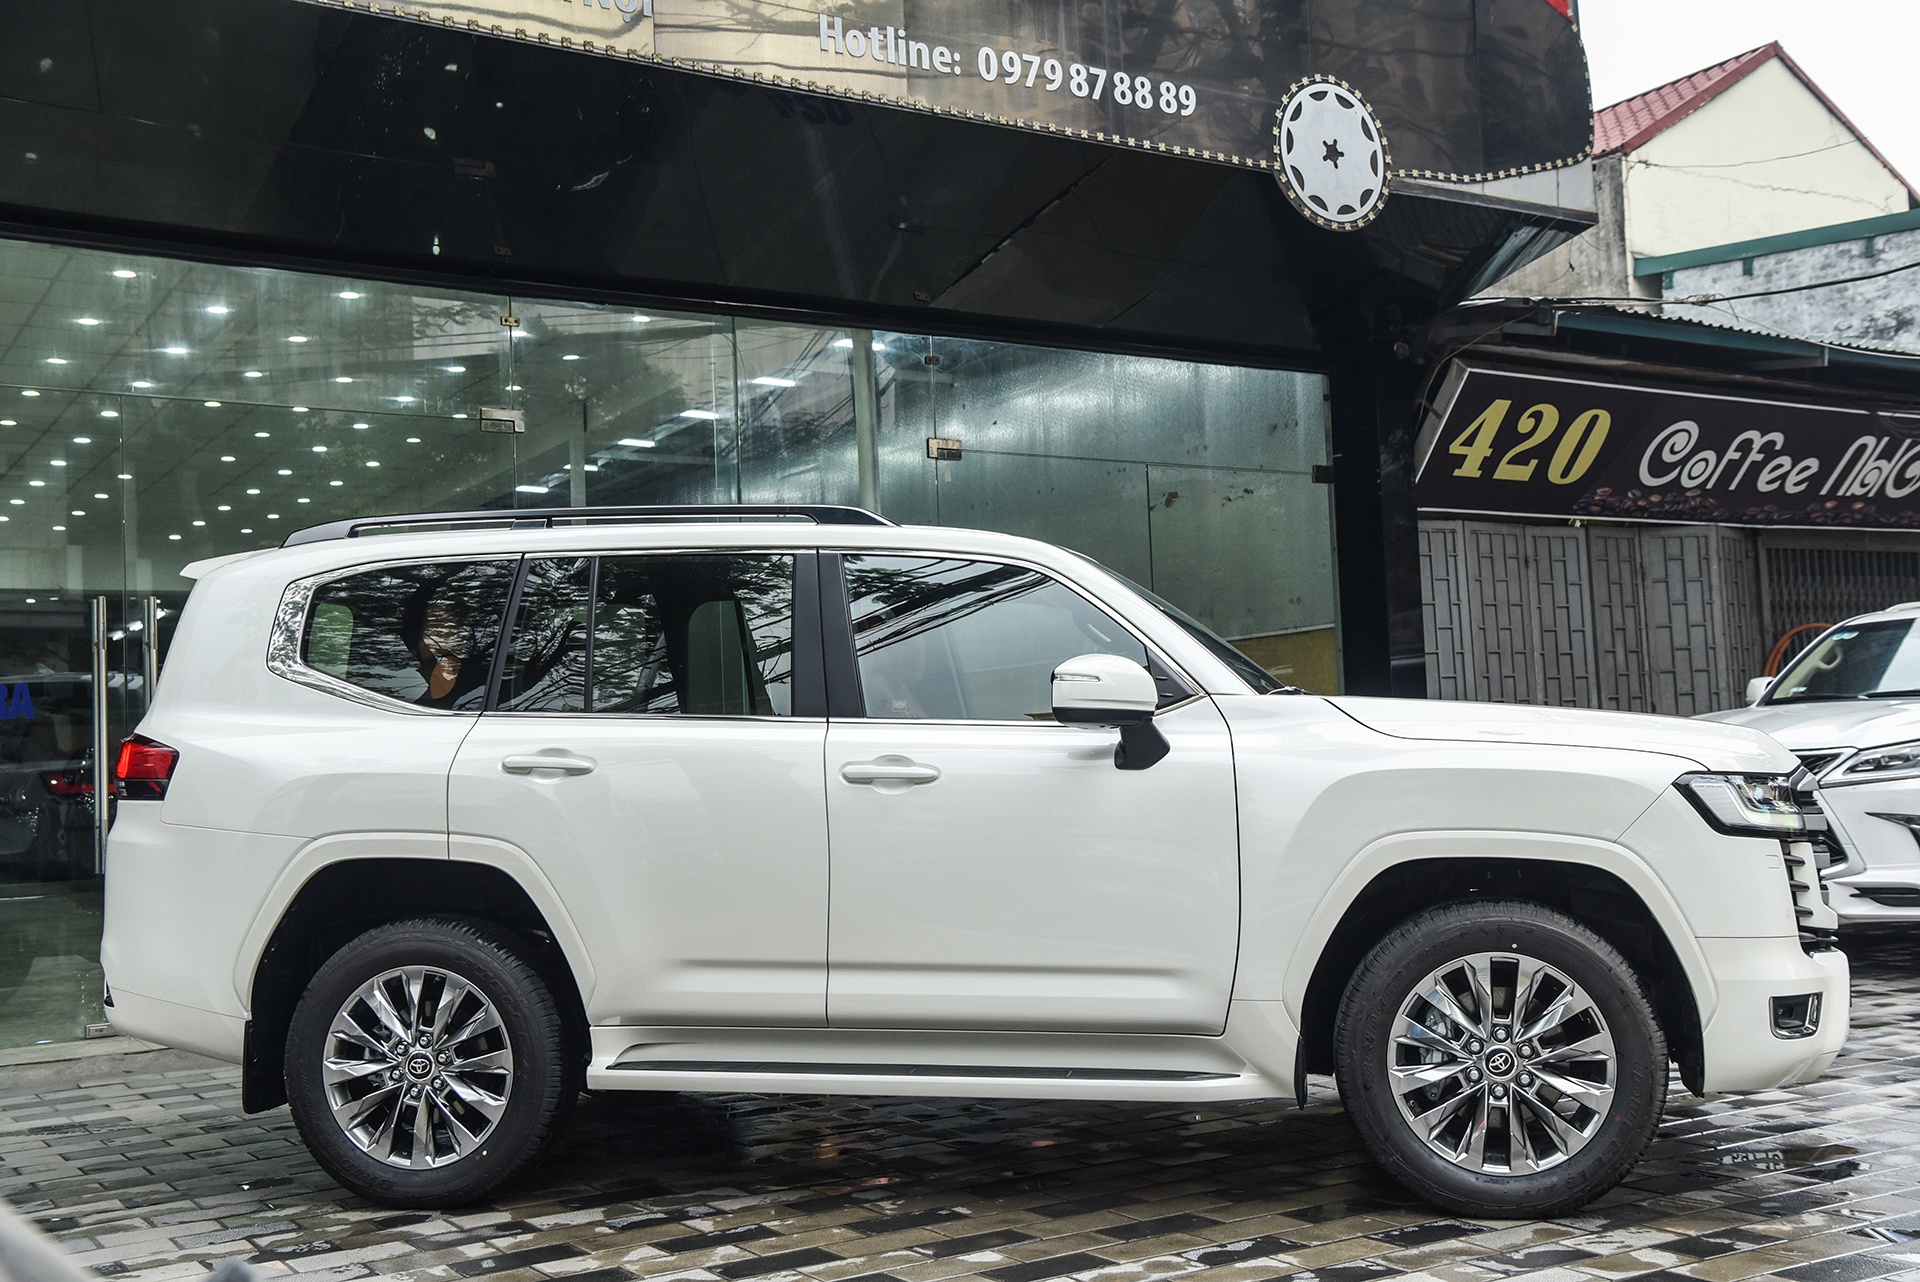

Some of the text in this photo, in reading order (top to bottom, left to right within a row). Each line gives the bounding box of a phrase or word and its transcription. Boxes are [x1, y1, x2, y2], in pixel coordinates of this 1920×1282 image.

[819, 13, 962, 75] Hotline:
[1449, 399, 1612, 485] 420
[1639, 420, 1820, 493] Coffee
